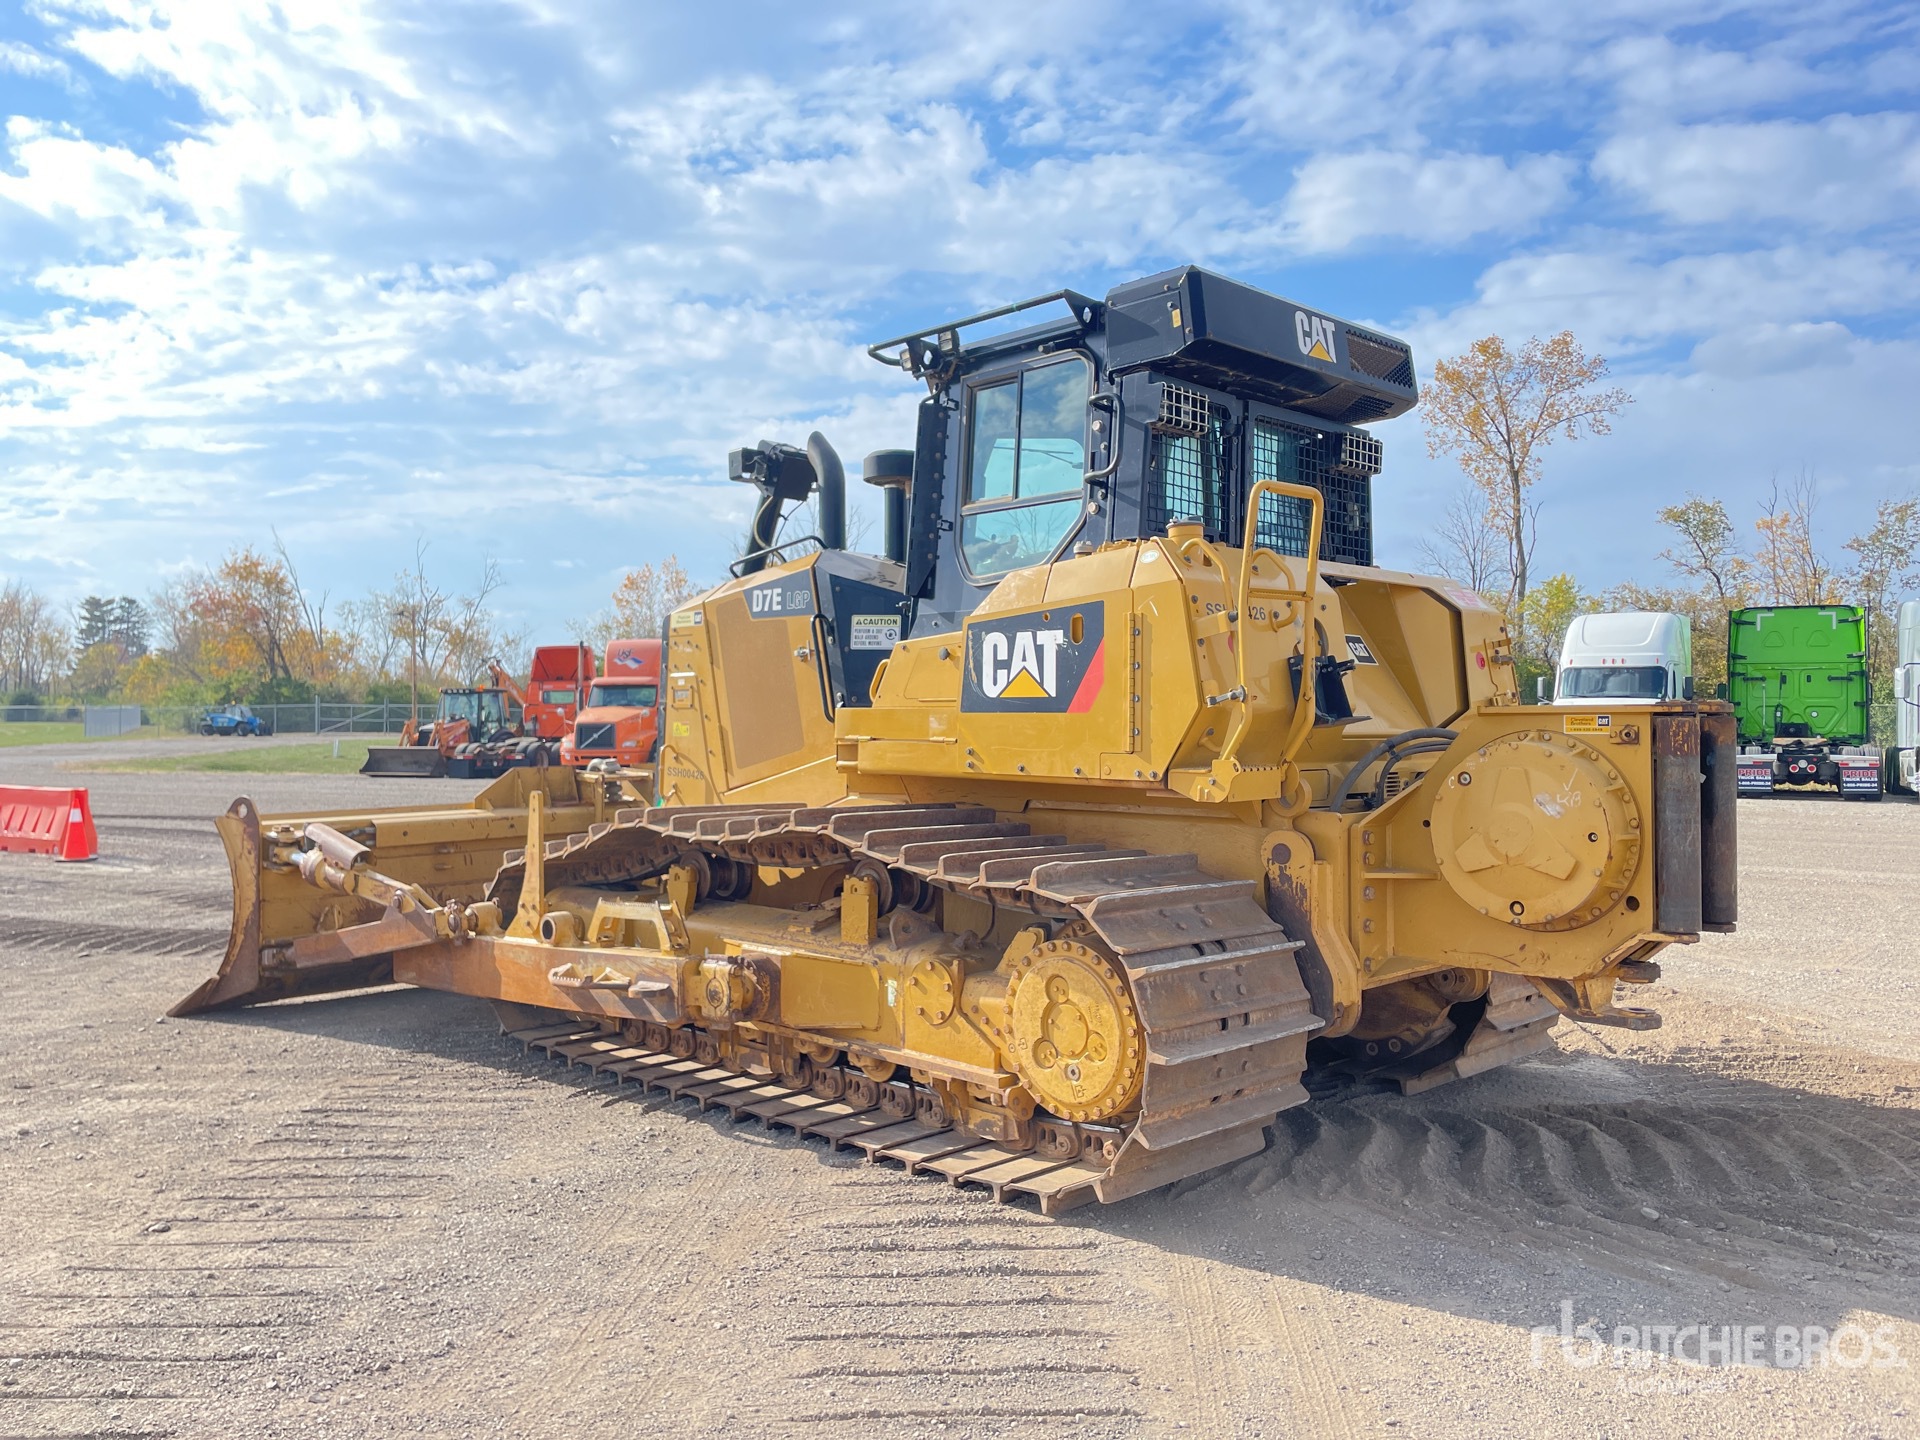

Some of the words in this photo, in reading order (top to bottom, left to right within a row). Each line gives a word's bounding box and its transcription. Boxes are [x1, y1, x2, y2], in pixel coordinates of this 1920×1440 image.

[1295, 311, 1336, 363] CAT
[752, 588, 782, 612] D7E
[786, 590, 810, 610] LGP
[862, 618, 898, 626] CAUTION
[1348, 642, 1370, 657] CAT
[982, 629, 1063, 698] CAT
[1737, 768, 1772, 776] PRIDE
[1842, 769, 1878, 778] PRIDE
